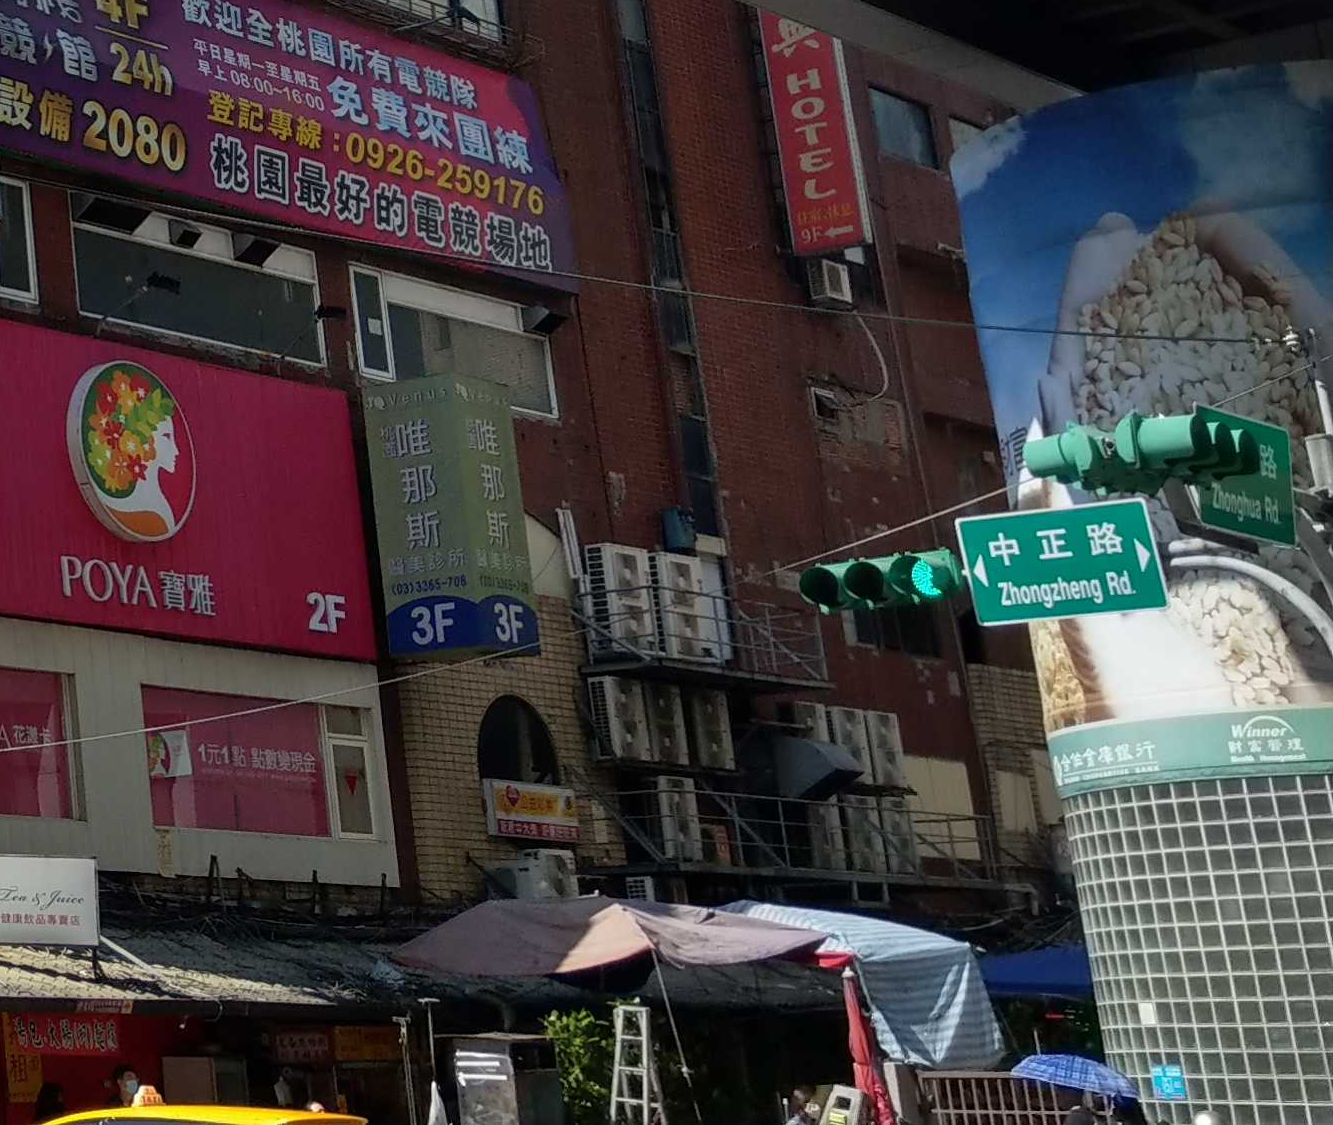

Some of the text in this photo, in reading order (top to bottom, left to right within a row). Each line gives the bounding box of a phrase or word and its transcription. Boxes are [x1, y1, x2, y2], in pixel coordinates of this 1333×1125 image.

[109, 41, 173, 97] 24h
[193, 38, 321, 92] 平日星期一至星期五
[198, 59, 227, 82] 早上
[83, 100, 187, 172] 2080
[325, 75, 534, 174] 免費來團練
[786, 68, 837, 201] HOTEL
[209, 133, 554, 272] 桃園最好的電競場地
[394, 419, 441, 549] 唯那斯
[474, 419, 510, 549] 唯那斯
[1212, 483, 1262, 522] Zhonghua
[987, 521, 1125, 567] 中正路
[60, 555, 217, 618] POYA 寶雅
[998, 571, 1138, 611] Zhongzheng Rd.
[305, 592, 346, 634] 2F
[411, 601, 455, 646] 3F
[494, 602, 524, 644] 3F
[1228, 737, 1305, 754] 財富管理
[1231, 725, 1288, 738] Winner
[1060, 741, 1157, 773] 合作金庫銀行
[0, 912, 81, 927] 健康飲品專賣店
[40, 889, 85, 911] Juice
